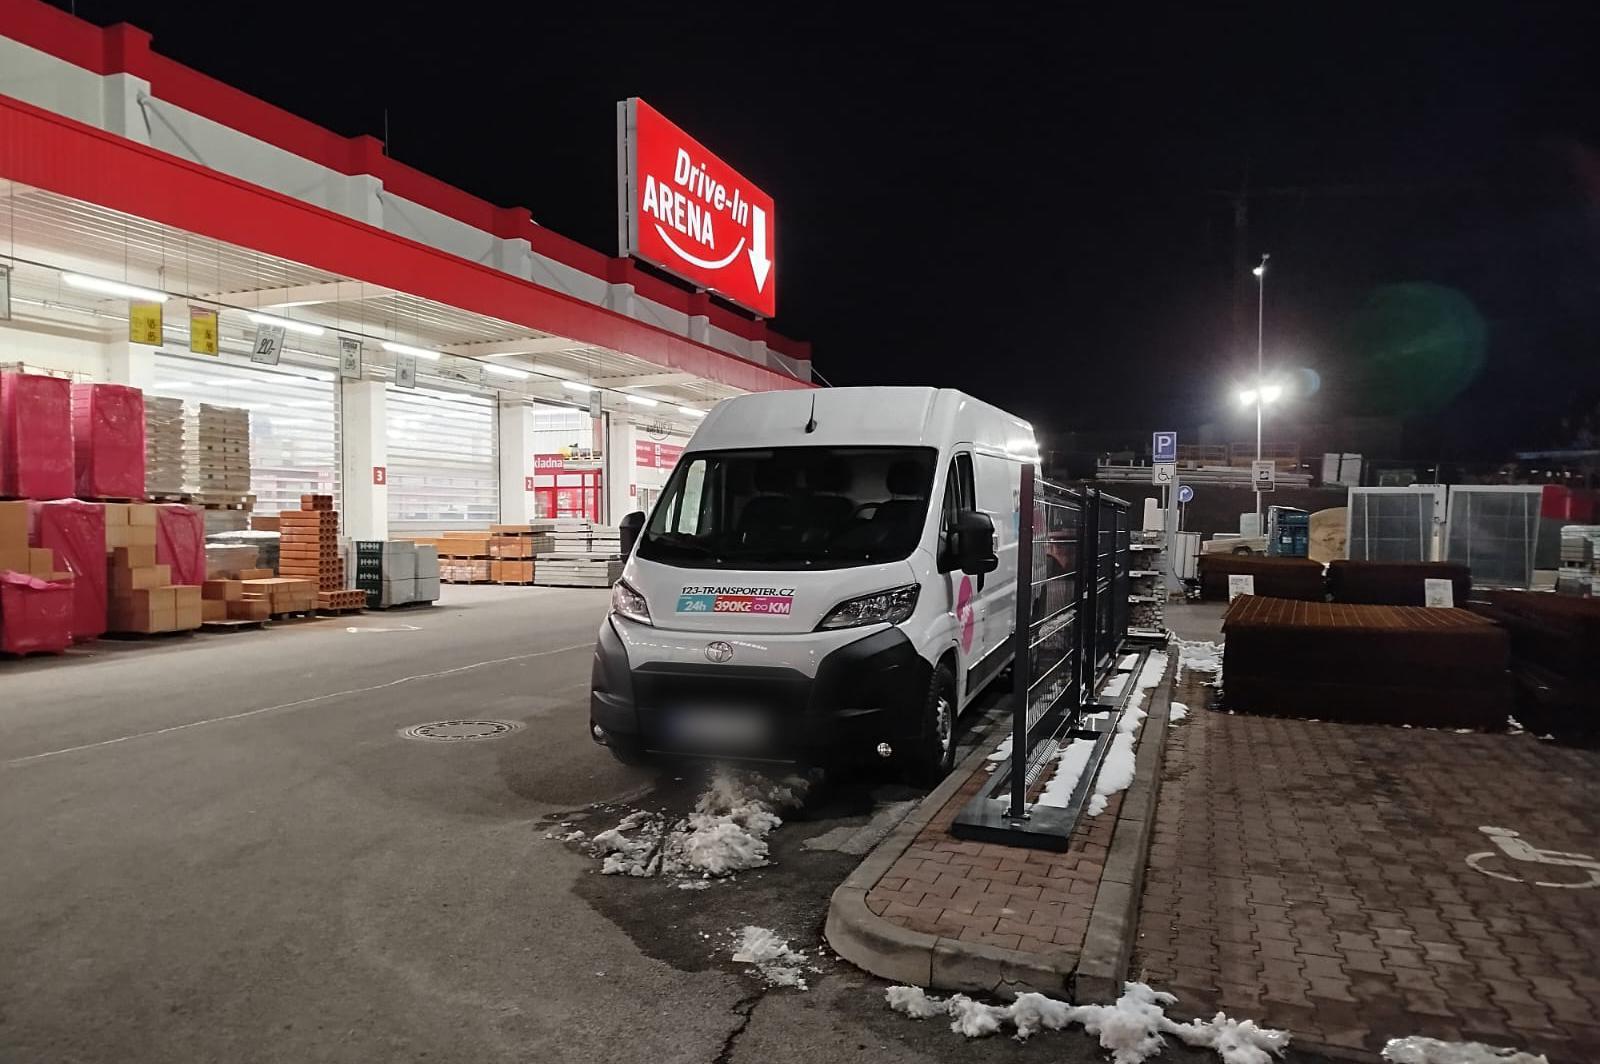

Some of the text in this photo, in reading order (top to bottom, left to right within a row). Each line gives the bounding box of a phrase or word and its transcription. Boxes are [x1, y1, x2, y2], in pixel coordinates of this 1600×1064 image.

[674, 147, 749, 227] Drive-In
[642, 175, 715, 250] ARENA
[1157, 435, 1172, 453] P
[376, 470, 383, 481] 3
[527, 479, 532, 489] 2
[681, 587, 795, 596] 123-TRANSPORTER.CZ
[685, 601, 706, 611] 24h
[714, 601, 752, 611] 390Kč
[768, 602, 790, 613] KM
